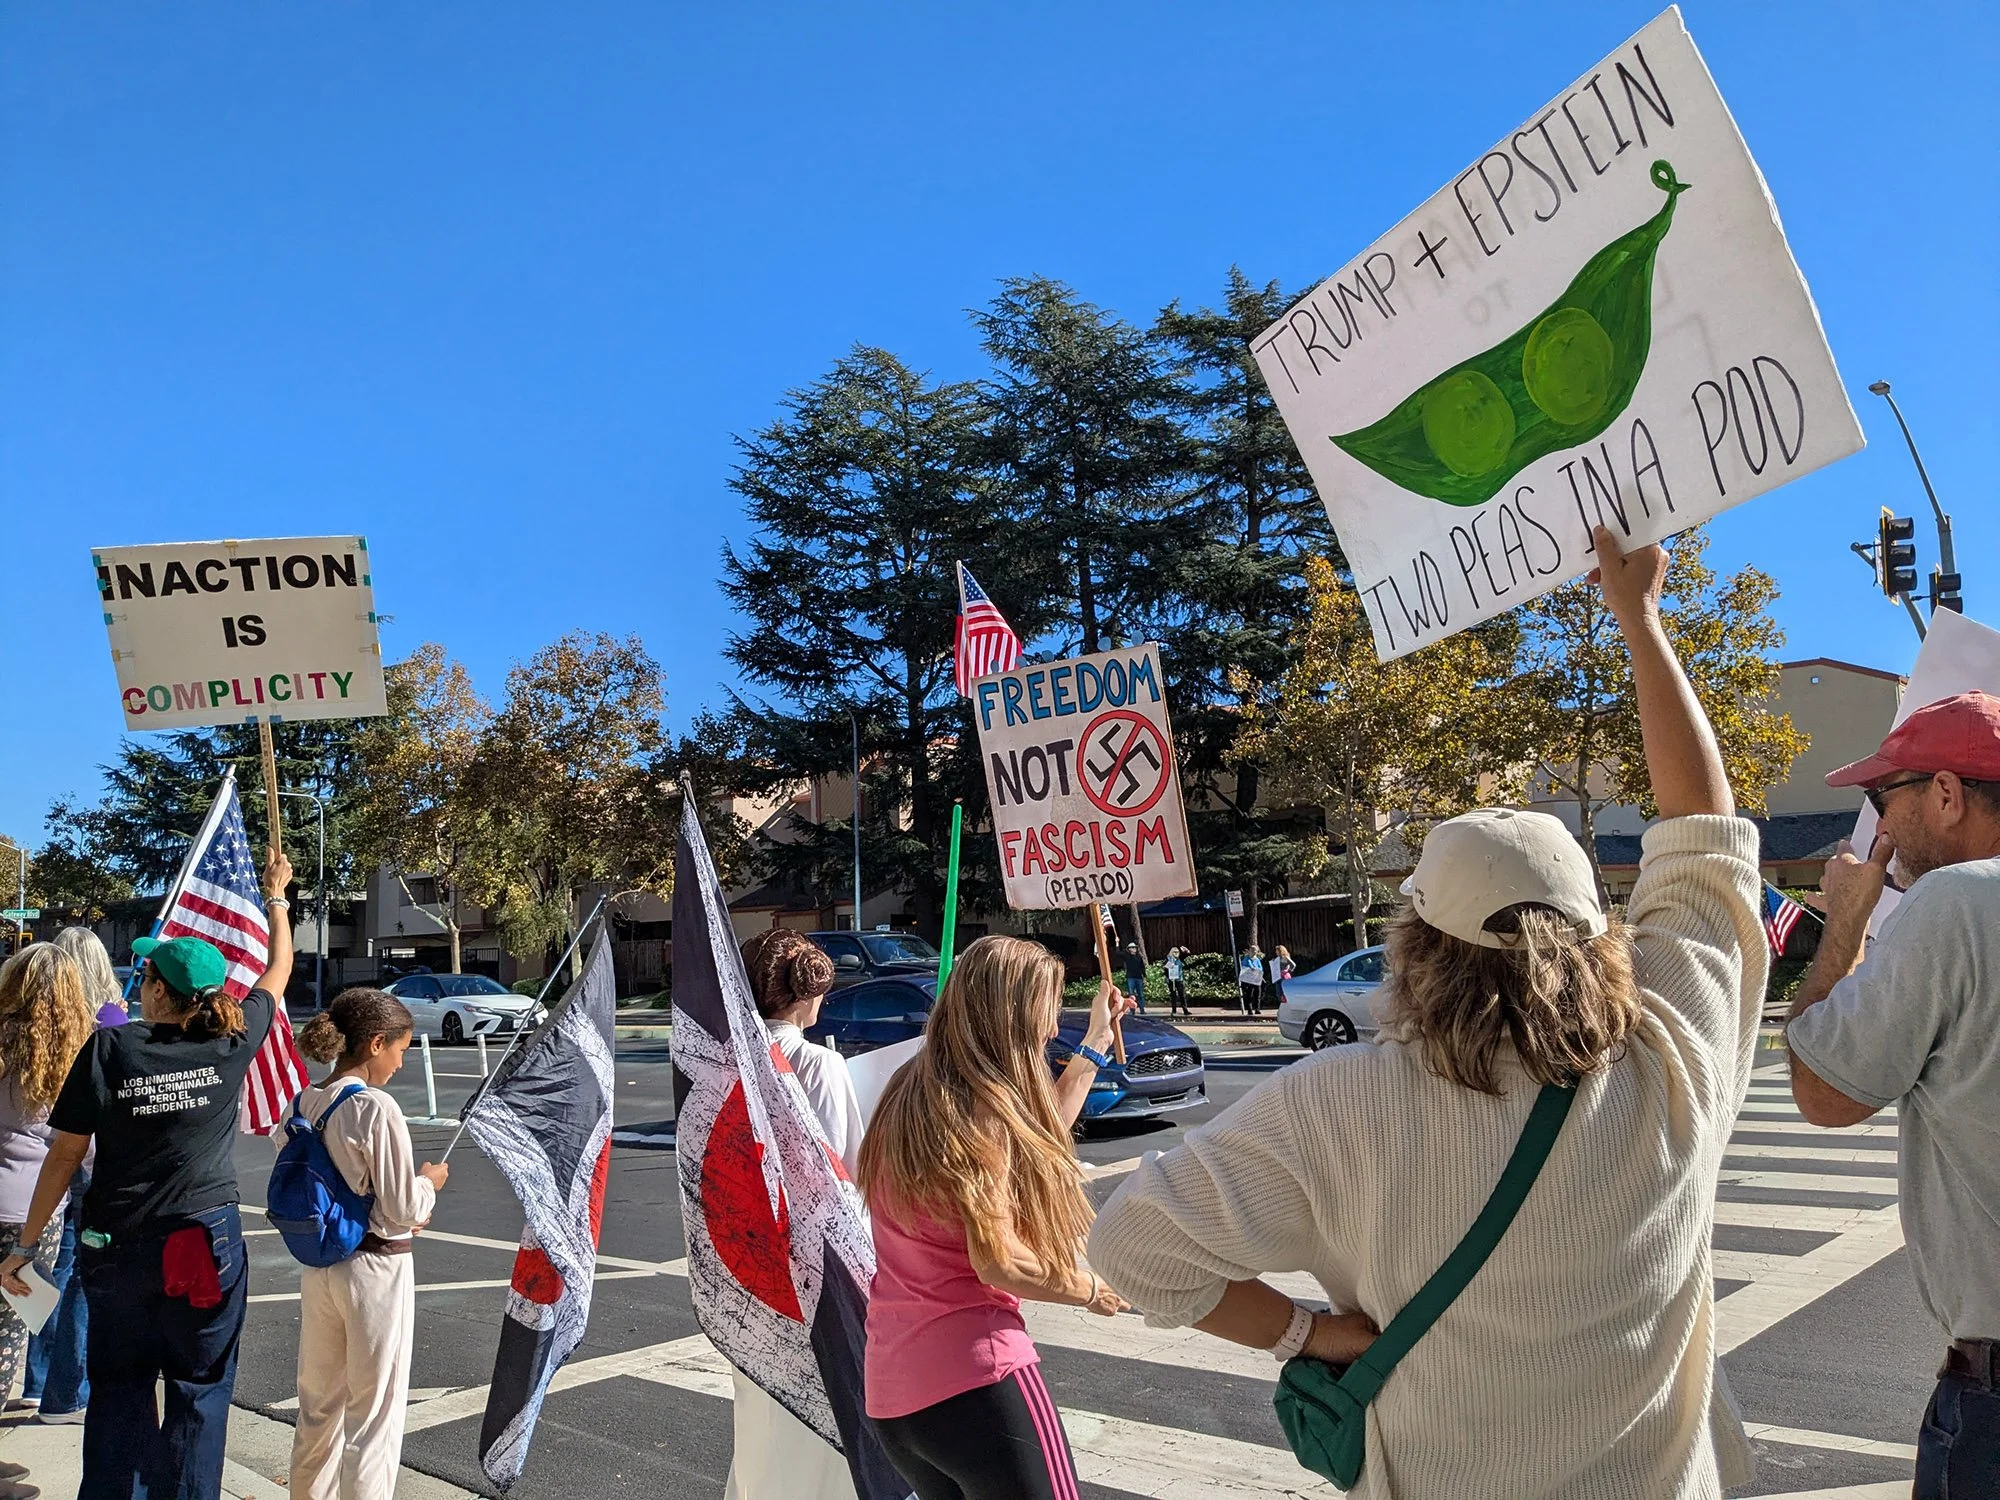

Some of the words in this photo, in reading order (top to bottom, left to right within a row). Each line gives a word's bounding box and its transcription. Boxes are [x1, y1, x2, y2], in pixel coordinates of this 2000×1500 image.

[1255, 252, 1397, 394] TRUMP
[1413, 231, 1448, 279] +
[1453, 43, 1676, 257] EPSTEIN
[1361, 550, 1449, 652] TWO
[1449, 485, 1563, 611] PEAS
[1691, 355, 1806, 497] POD
[97, 553, 358, 601] INACTION
[222, 614, 267, 648] IS
[122, 671, 353, 715] COMPLICITY
[977, 652, 1161, 731] FREEDOM
[991, 739, 1074, 806] NOT
[1000, 815, 1175, 878] FASCISM
[1045, 867, 1134, 907] (PERIOD)
[117, 1089, 132, 1099] NO
[134, 1086, 156, 1096] SON
[157, 1075, 223, 1093] CRIMINALES,
[123, 1077, 143, 1089] LOS
[145, 1066, 215, 1086] INMIGRANTES
[149, 1092, 177, 1104] PERO
[178, 1090, 191, 1100] EL
[132, 1099, 196, 1116] PRESIDENTE
